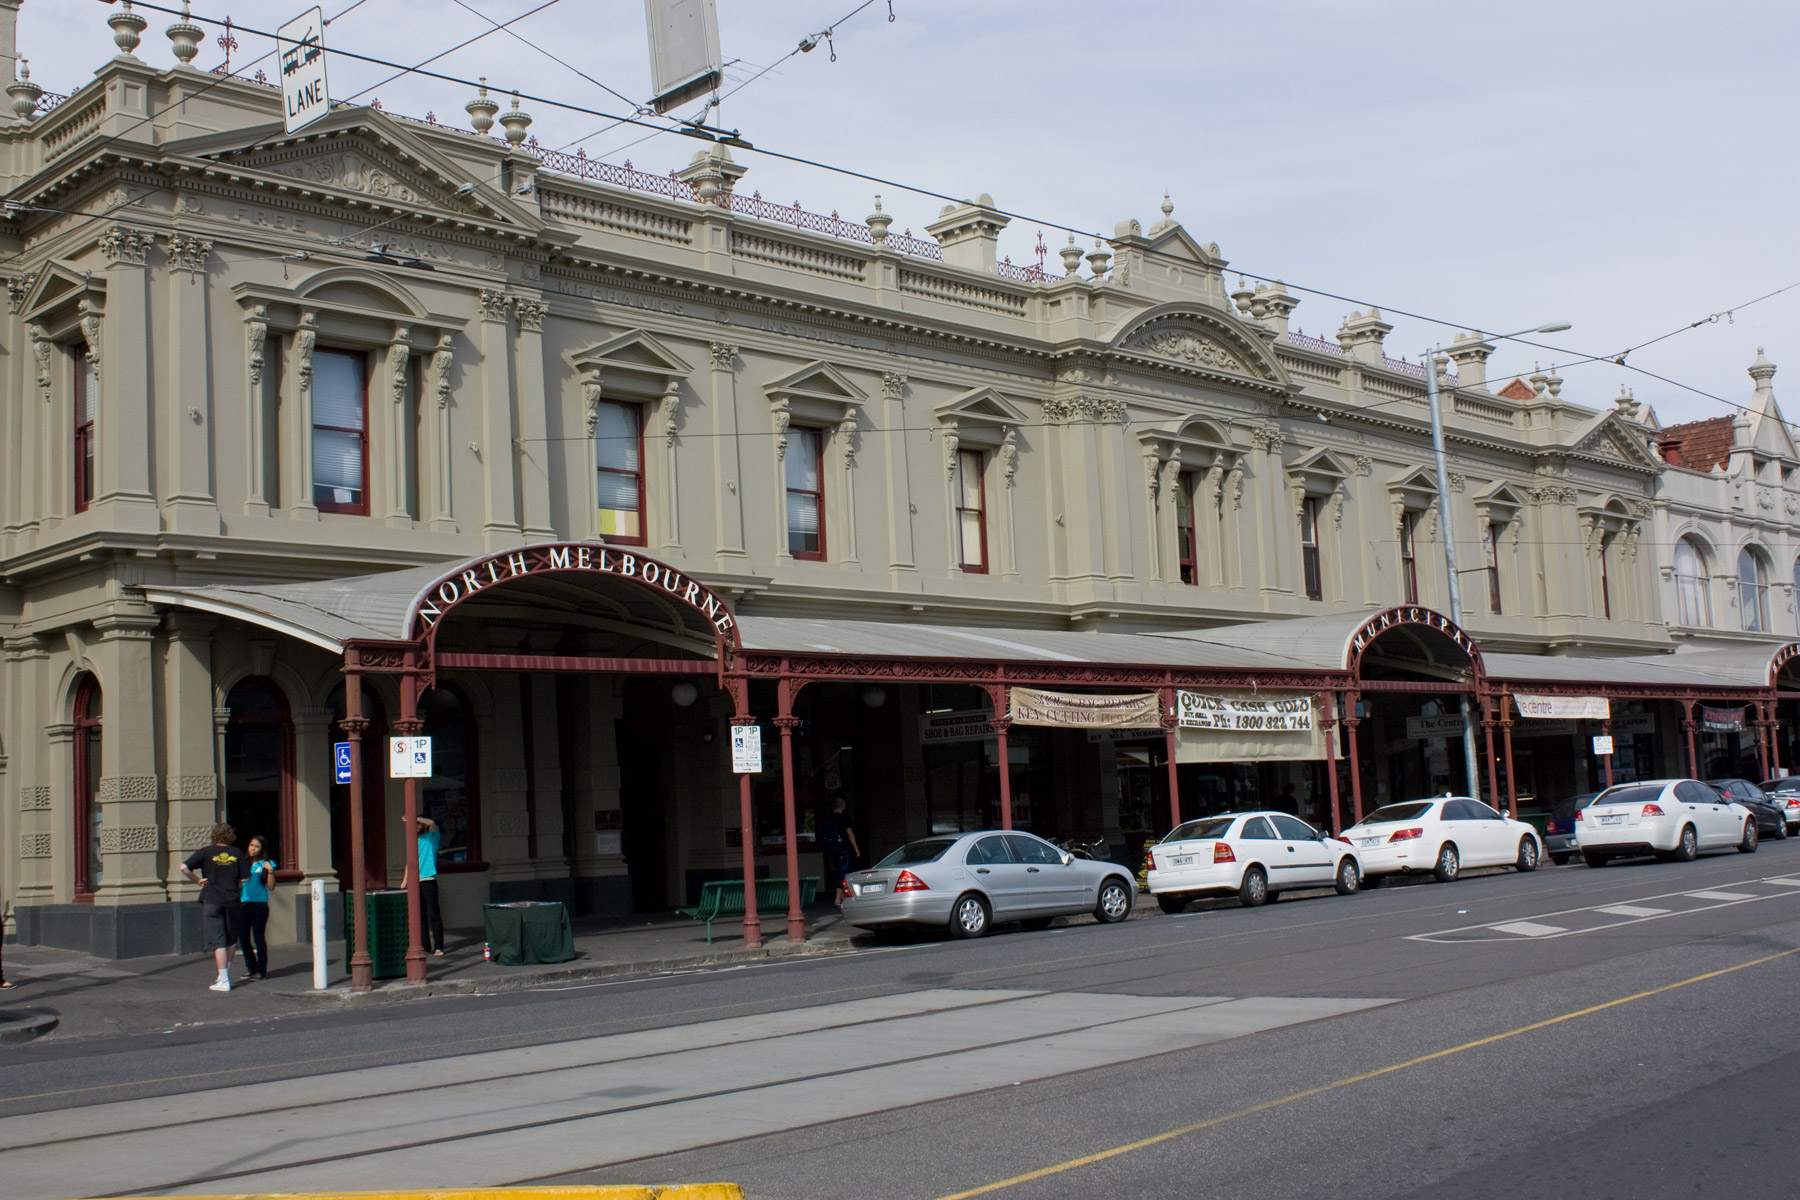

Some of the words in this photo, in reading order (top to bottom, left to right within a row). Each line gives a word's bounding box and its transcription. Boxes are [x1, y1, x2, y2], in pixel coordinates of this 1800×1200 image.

[288, 78, 323, 117] LANE
[417, 551, 529, 628] NORTH
[548, 546, 734, 637] MELBOURNE
[1354, 607, 1473, 657] MUNICIPAL
[1033, 693, 1064, 706] SHOE
[1180, 693, 1227, 711] QUICK
[1230, 700, 1269, 713] CASH
[1273, 698, 1309, 713] GOLD
[1017, 707, 1041, 720] KEY
[1046, 709, 1095, 723] CUTTING
[1528, 701, 1552, 714] centre
[1212, 713, 1231, 728] Ph:
[1235, 715, 1263, 729] 1300
[1265, 716, 1287, 730] 322
[1289, 716, 1310, 729] 744
[1419, 720, 1435, 729] The
[734, 726, 744, 736] 1P
[748, 726, 758, 735] 1P
[925, 728, 942, 739] SHOE
[943, 728, 949, 737] &
[950, 727, 964, 737] BAG
[965, 724, 994, 735] REPAIRS
[1132, 729, 1163, 737] EXCHANGE
[414, 739, 427, 749] 1P
